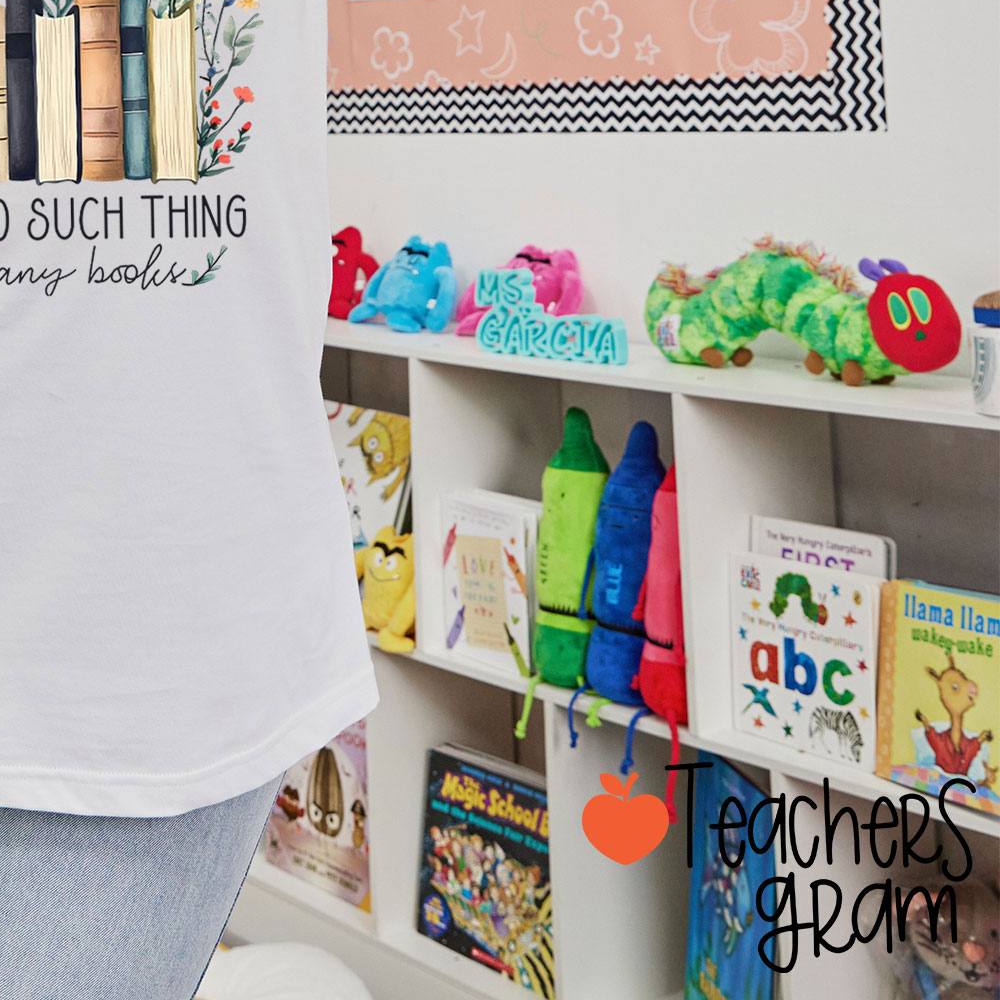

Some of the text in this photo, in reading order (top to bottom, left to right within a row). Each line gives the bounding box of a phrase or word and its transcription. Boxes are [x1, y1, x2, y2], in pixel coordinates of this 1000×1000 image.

[27, 196, 124, 241] SUCH
[141, 194, 247, 239] THING
[88, 244, 188, 290] books
[479, 273, 523, 305] MS
[478, 312, 617, 363] GARCIA
[766, 529, 778, 540] The
[780, 532, 796, 545] Very
[798, 536, 824, 550] Hungry
[462, 554, 494, 577] LOVE
[904, 593, 954, 627] llama
[911, 626, 994, 657] wakey-wake
[749, 636, 856, 706] abc
[441, 770, 487, 811] Magic
[487, 788, 541, 833] School
[463, 775, 481, 791] The
[431, 799, 450, 814] and
[450, 804, 467, 821] the
[468, 811, 503, 835] Science
[504, 826, 524, 843] Fair
